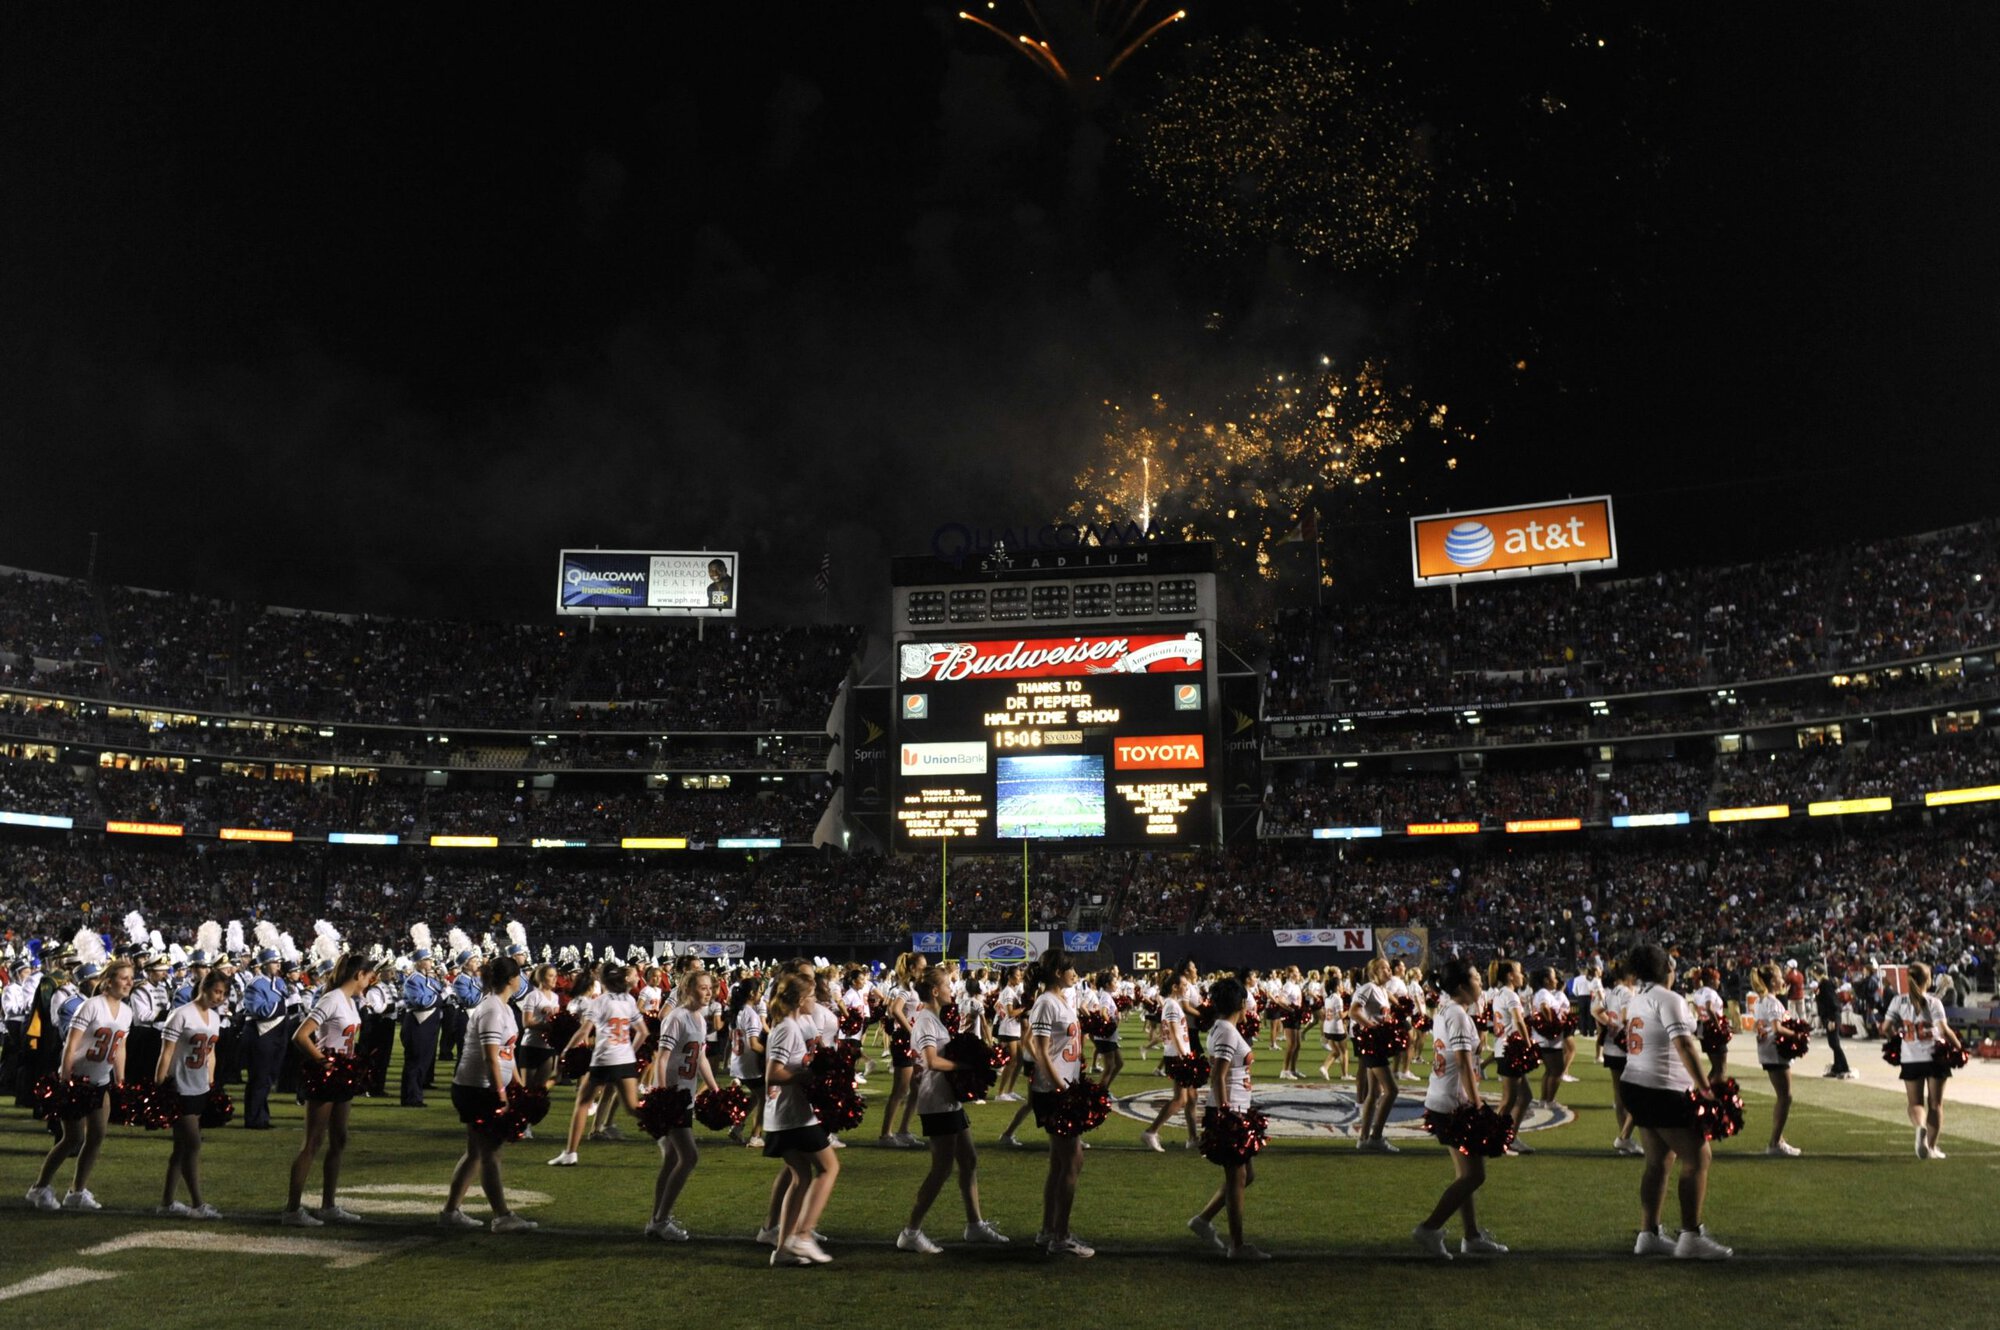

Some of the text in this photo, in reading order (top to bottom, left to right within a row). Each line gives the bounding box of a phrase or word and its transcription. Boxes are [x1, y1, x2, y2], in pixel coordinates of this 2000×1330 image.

[1504, 516, 1586, 554] at&t
[653, 560, 707, 569] PALOMAR
[980, 553, 1149, 571] STADIUM
[567, 569, 645, 586] QUALCOMM
[653, 569, 707, 578] POMERADO
[581, 586, 632, 594] Innovation
[653, 578, 707, 587] HEALTH
[928, 637, 1129, 681] Budweiser
[1131, 644, 1199, 665] American Lager
[1016, 681, 1082, 693] THANKS TO
[1006, 694, 1093, 709] DR PEPPER
[984, 709, 1120, 725] HALFTIME SHOW
[996, 730, 1042, 747] 15:06
[923, 753, 985, 765] UnionBank
[1118, 744, 1200, 762] TOYOTA
[987, 937, 1014, 949] PACIFIC
[1344, 930, 1365, 949] N
[1136, 952, 1157, 969] 25
[1628, 1016, 1644, 1056] 6
